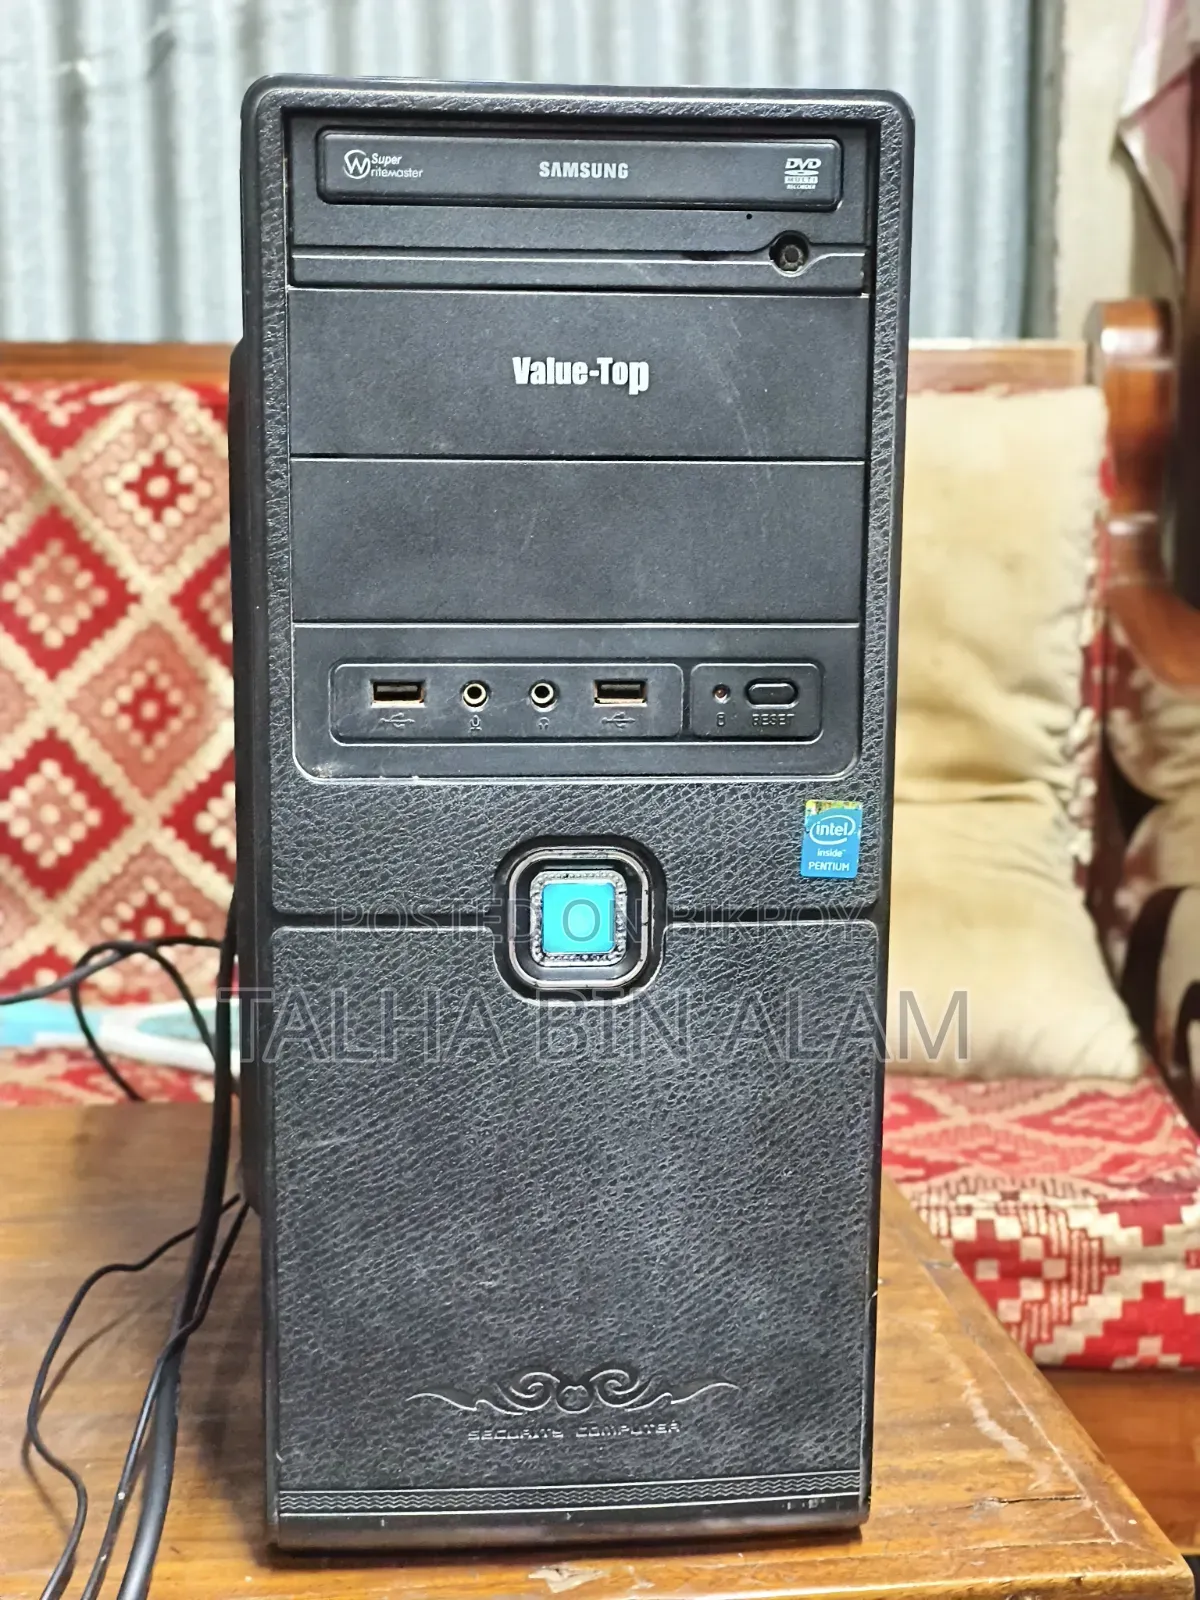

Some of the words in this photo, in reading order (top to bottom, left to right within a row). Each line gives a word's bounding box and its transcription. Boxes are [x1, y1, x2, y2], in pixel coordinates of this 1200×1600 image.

[371, 152, 403, 167] Super
[784, 157, 822, 171] DVD
[539, 161, 629, 179] SAMSUNG
[511, 356, 650, 396] Value-Top
[752, 712, 796, 726] RESET
[815, 821, 849, 837] intel
[808, 861, 850, 872] PENTIUM
[575, 1421, 680, 1438] COMPUTER
